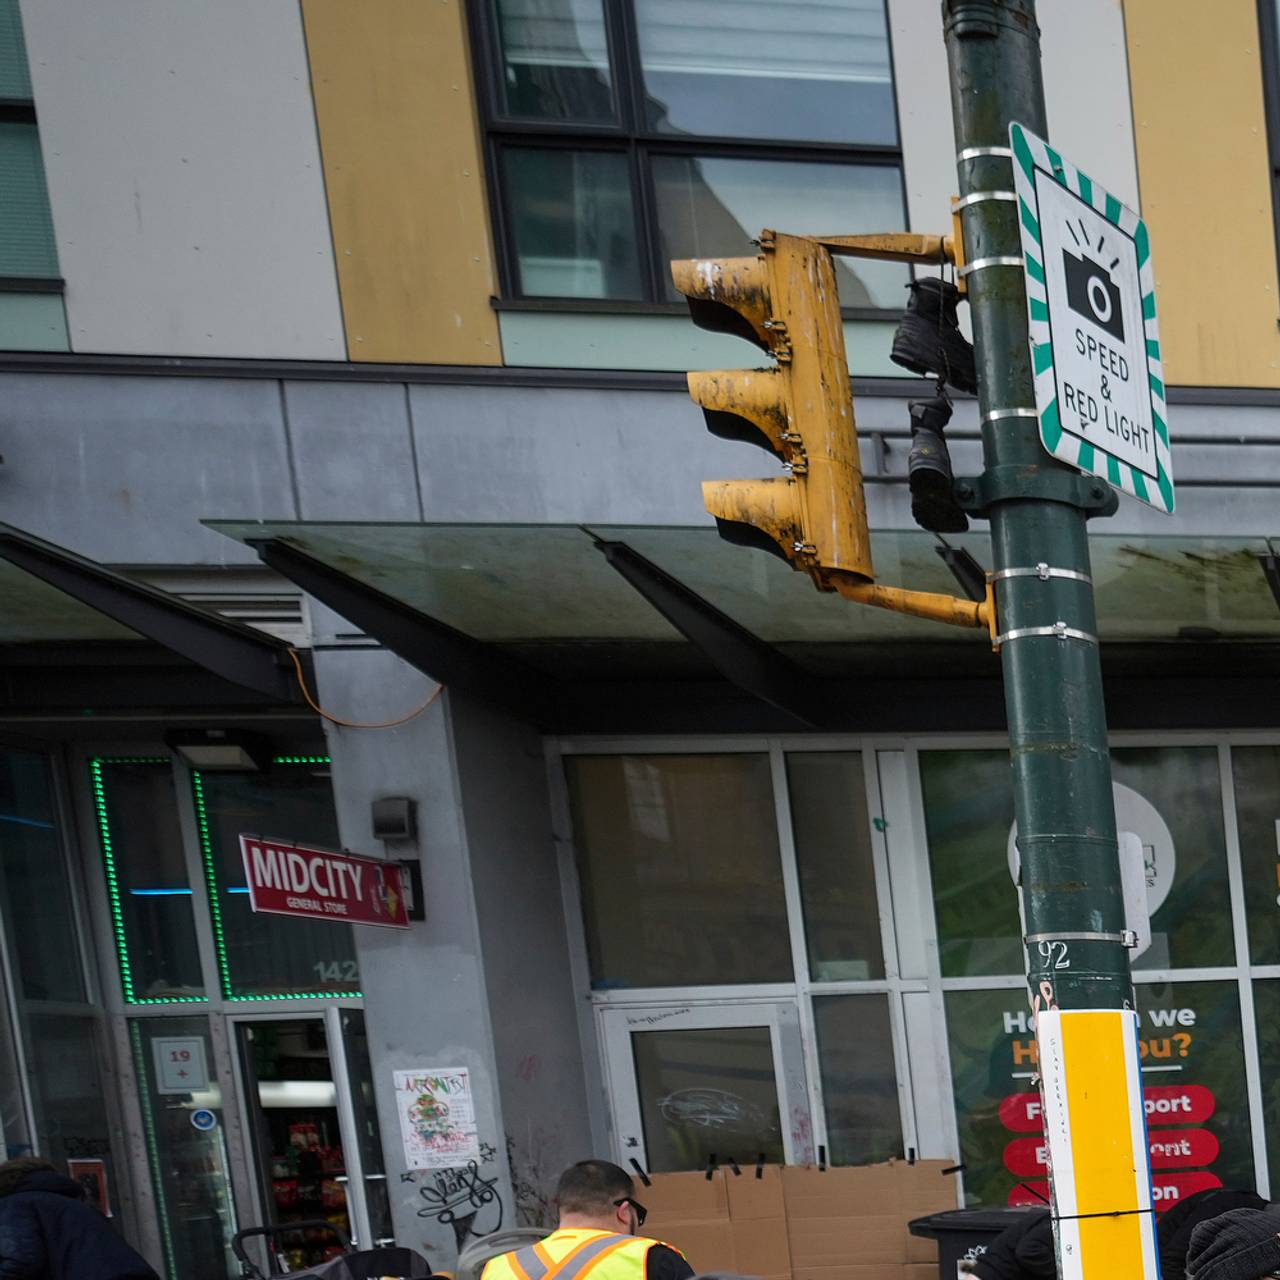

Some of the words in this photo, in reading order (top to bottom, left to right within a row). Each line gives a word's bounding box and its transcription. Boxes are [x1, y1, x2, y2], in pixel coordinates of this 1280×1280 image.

[1075, 326, 1129, 382] SPEED
[1100, 374, 1113, 403] &
[1064, 382, 1099, 423] RED
[1104, 404, 1149, 454] LIGHT
[251, 846, 363, 902] MIDCITY
[286, 896, 322, 912] GENERAL
[324, 901, 349, 915] STORE
[1039, 940, 1071, 969] 92
[314, 960, 359, 983] 142
[1148, 1007, 1197, 1028] we
[170, 1049, 191, 1063] 19
[1138, 1032, 1193, 1058] ou?
